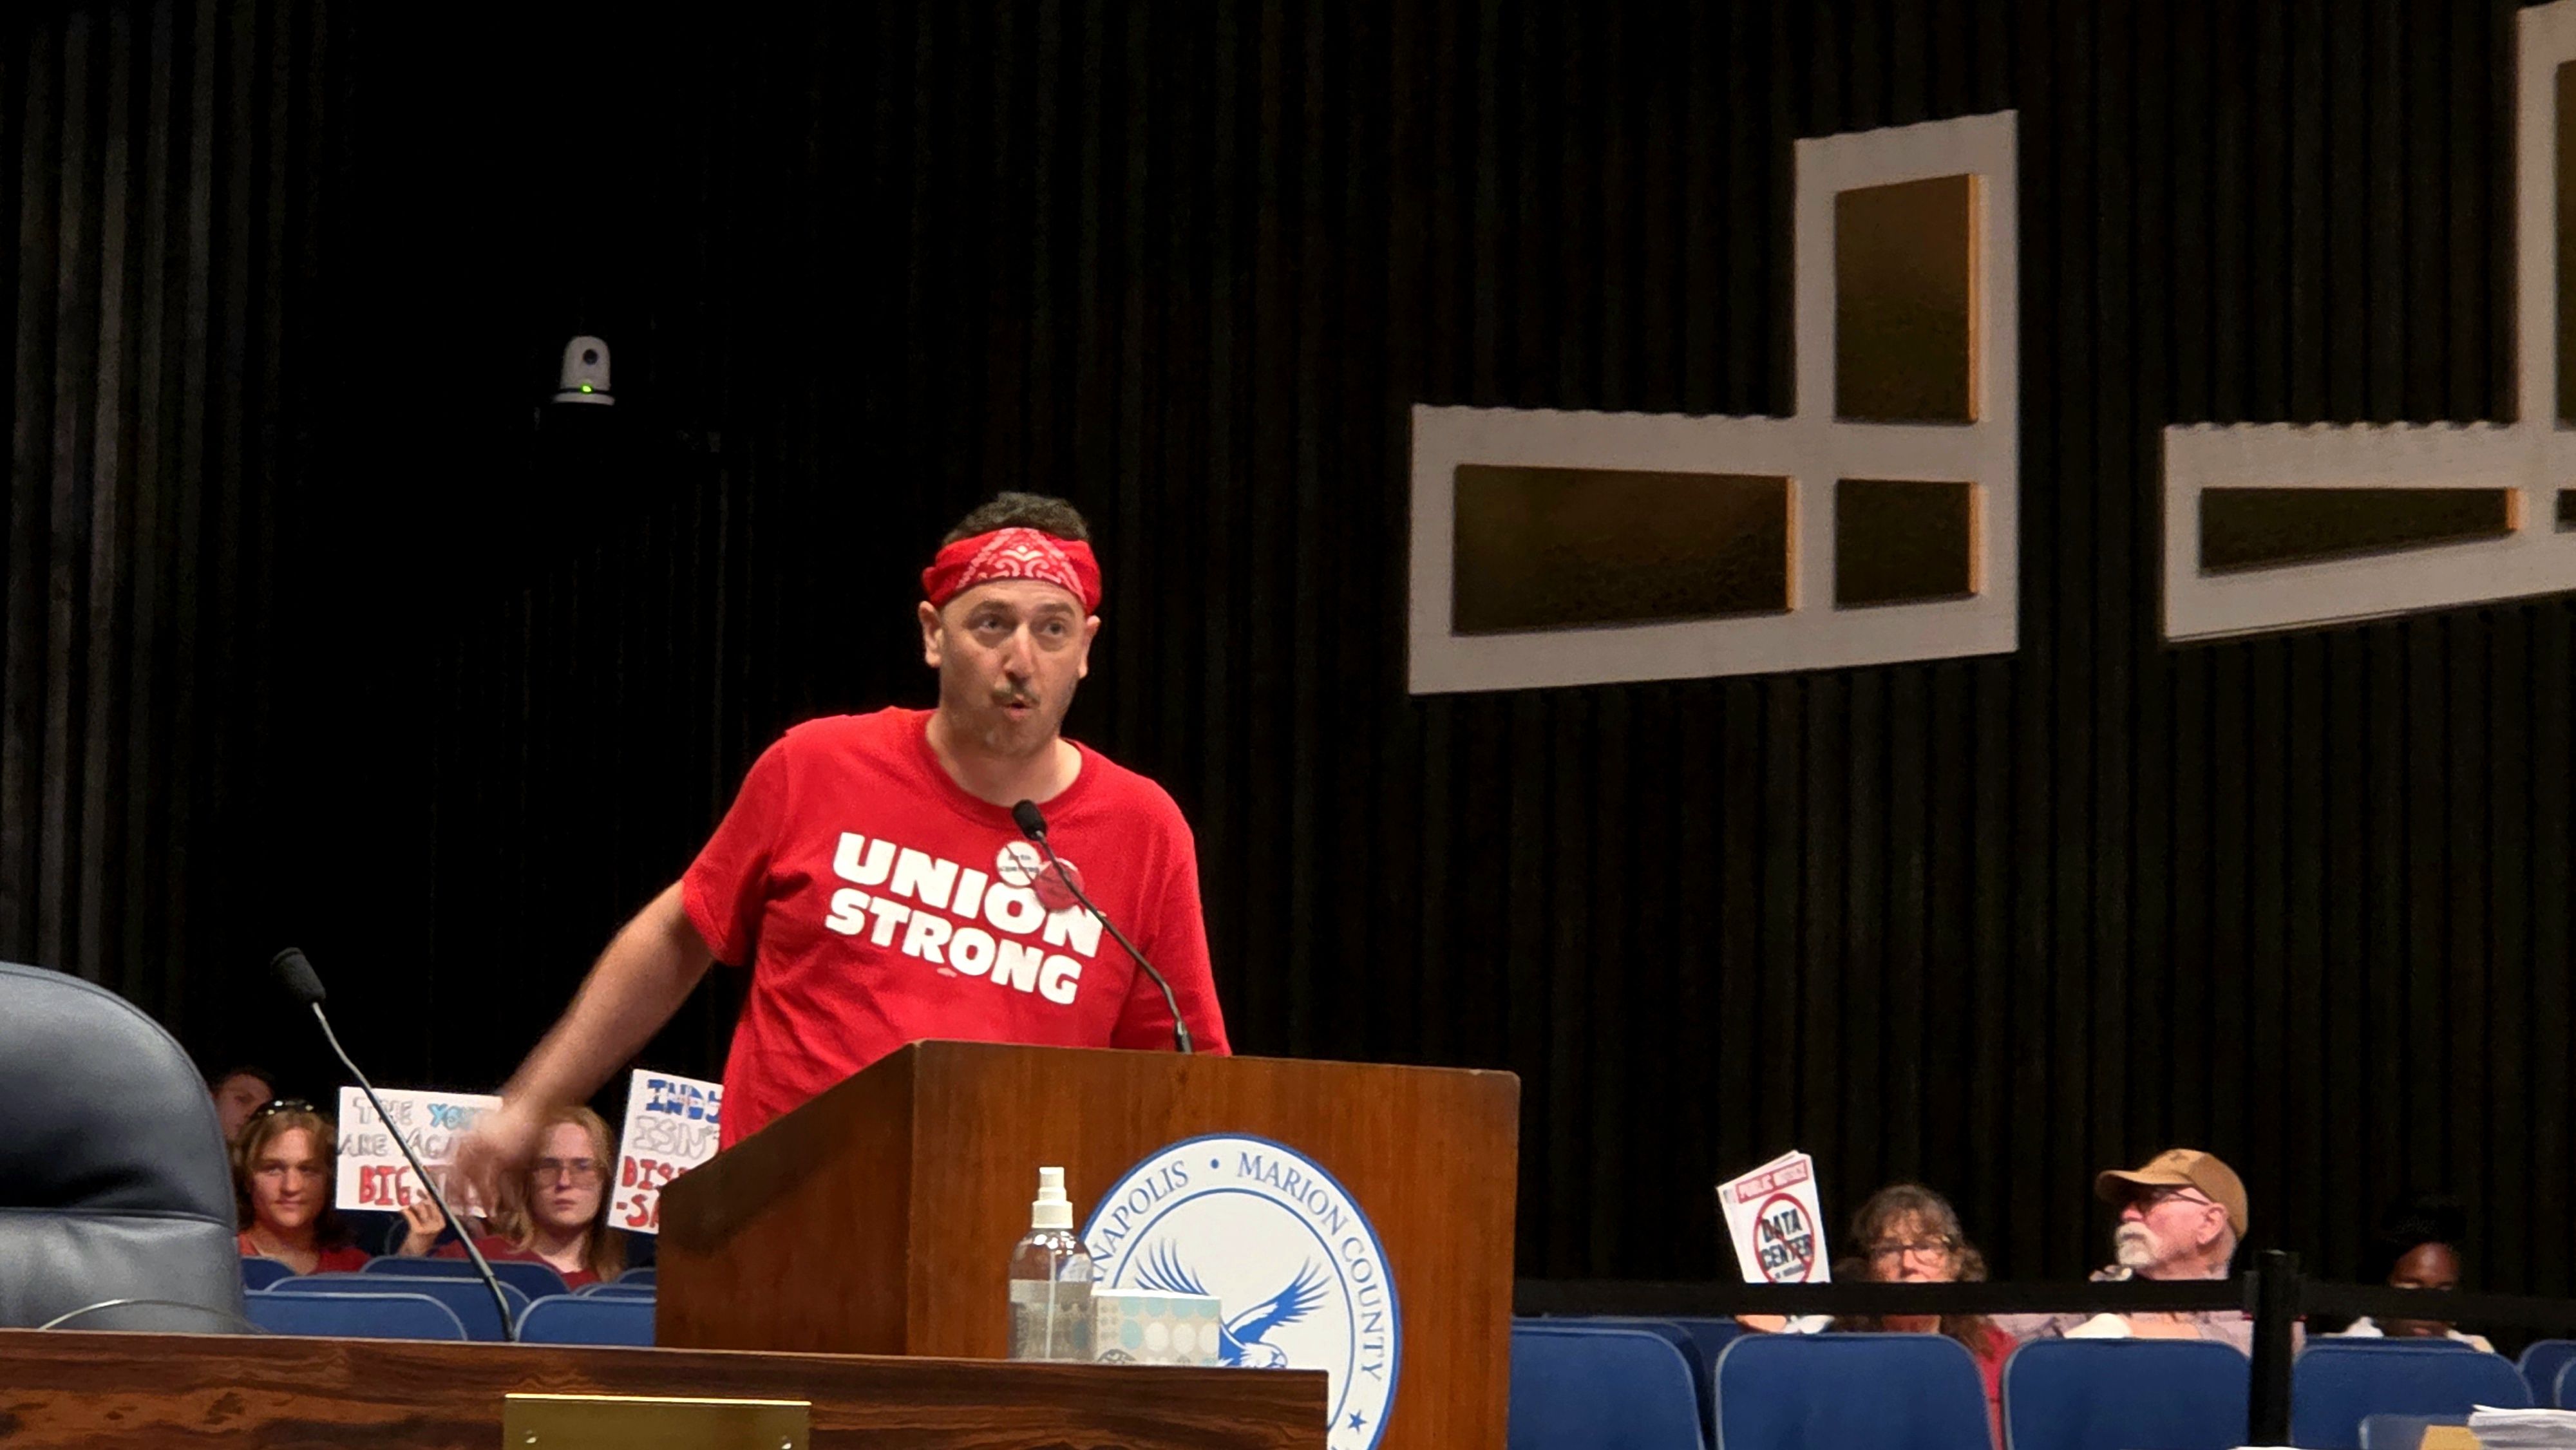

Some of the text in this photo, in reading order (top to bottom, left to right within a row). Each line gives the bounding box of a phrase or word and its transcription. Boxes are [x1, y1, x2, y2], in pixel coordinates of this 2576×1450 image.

[833, 832, 1104, 957] UNION
[826, 888, 1083, 1004] STRONG
[337, 1133, 388, 1157] ARE
[359, 1165, 411, 1207] BIG
[1761, 1208, 1803, 1243] DATA
[1237, 1152, 1349, 1236] MARION
[1341, 1237, 1385, 1381] COUNTY
[1761, 1234, 1814, 1271] CENTER
